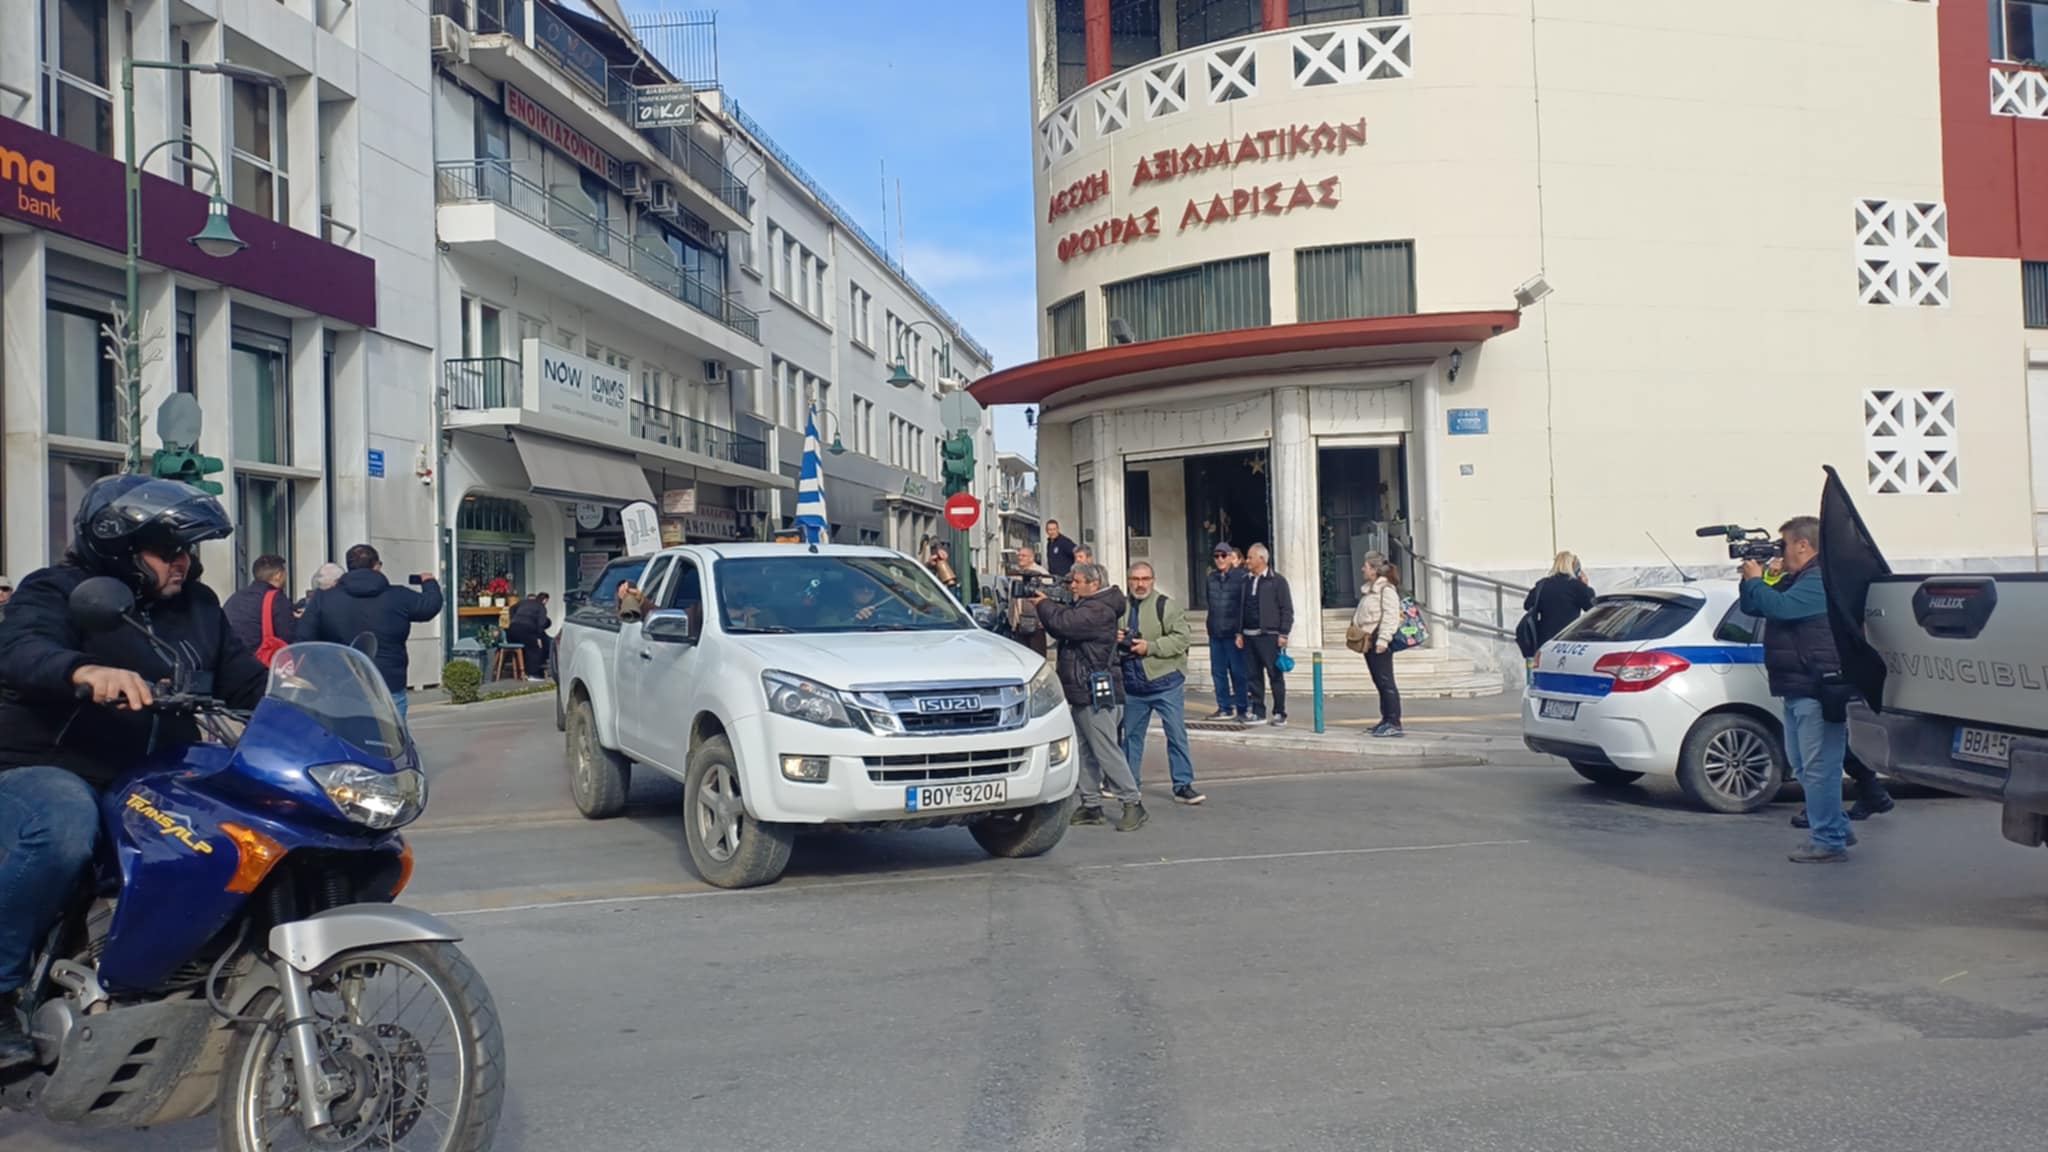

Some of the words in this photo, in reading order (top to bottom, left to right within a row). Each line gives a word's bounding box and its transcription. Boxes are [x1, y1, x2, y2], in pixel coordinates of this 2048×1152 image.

[508, 88, 607, 177] ΕΝΟΙΚΙΑΖΟΝΤΑΙ
[1048, 168, 1110, 225] ΛΕΣΧΗ
[1132, 117, 1367, 188] ΑΞΙΩΜΑΤΙΚΩΝ
[18, 187, 62, 222] bank
[1057, 206, 1161, 263] ΦΡΟΥΡΑΣ
[1178, 175, 1340, 232] ΛΑΡΙΣΑΣ
[544, 358, 583, 389] NOW
[1929, 597, 1966, 609] HILUX
[1551, 643, 1589, 656] POLICE
[920, 698, 979, 711] ISUZU
[1964, 730, 2016, 756] BBA-5
